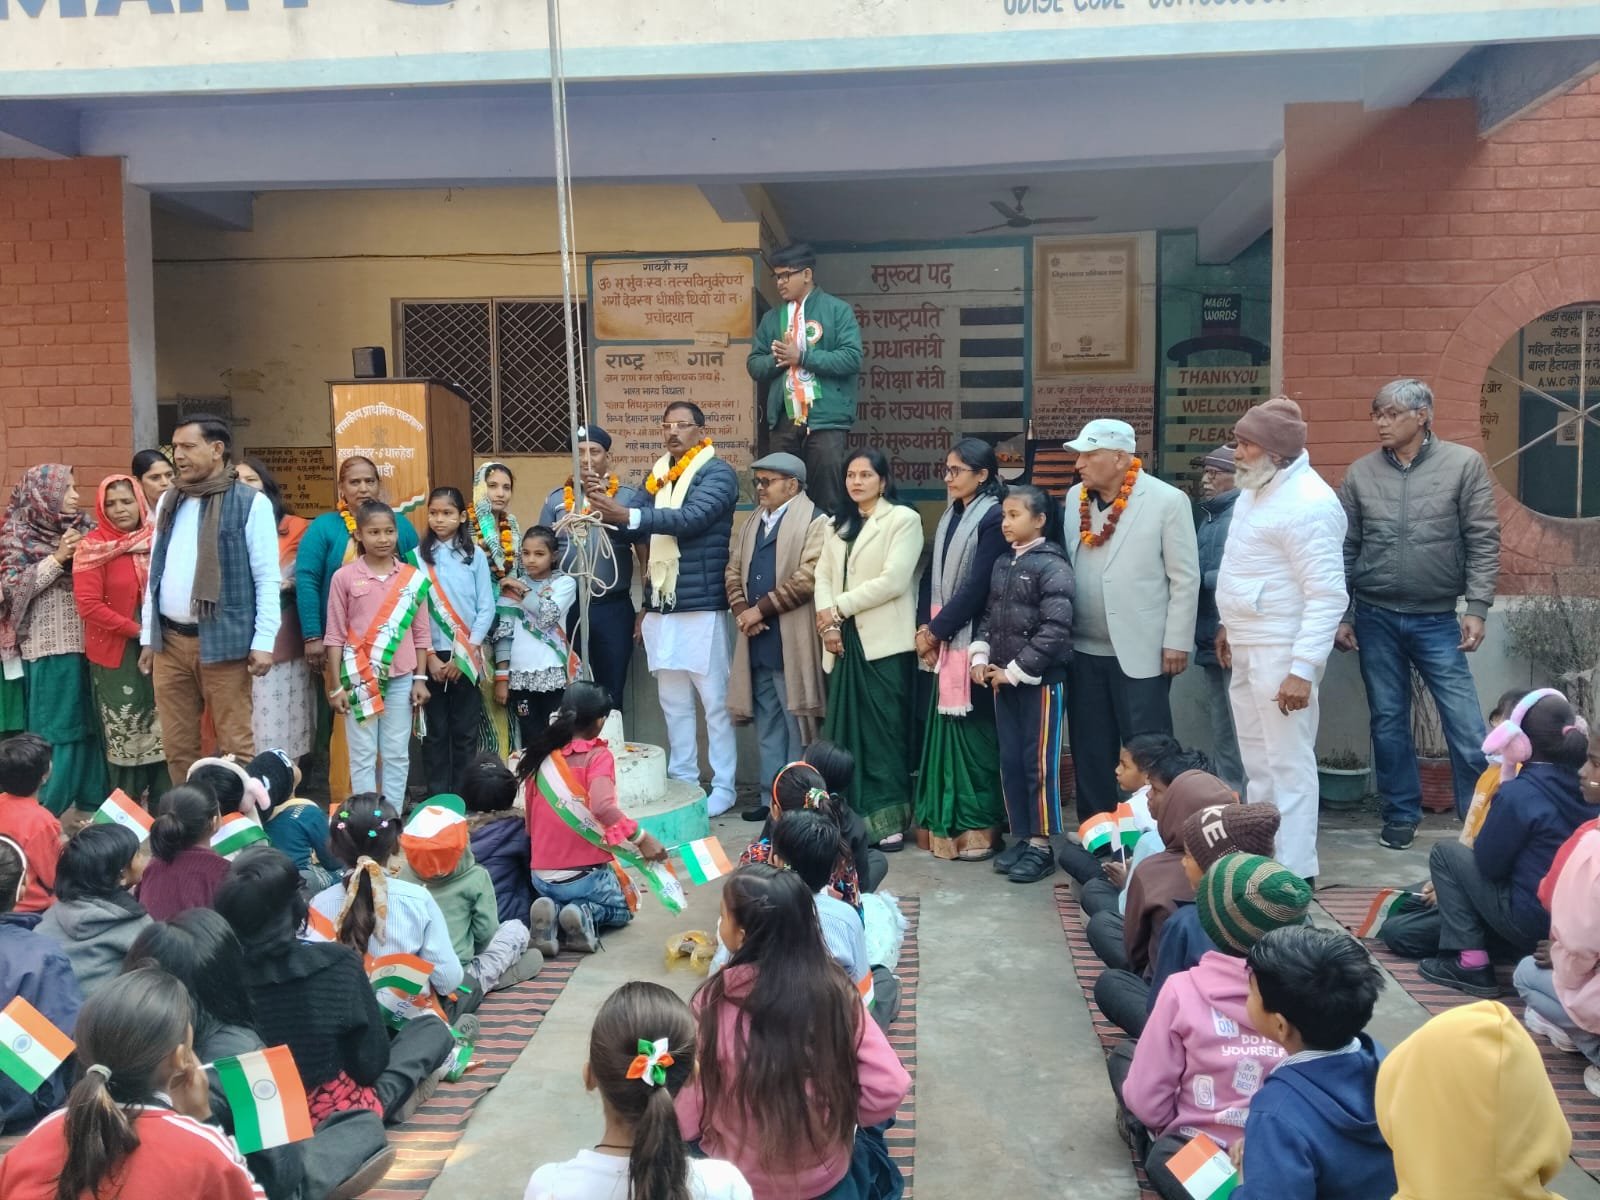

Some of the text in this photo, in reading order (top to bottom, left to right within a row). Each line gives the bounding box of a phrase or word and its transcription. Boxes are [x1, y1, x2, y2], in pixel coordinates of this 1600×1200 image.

[643, 261, 689, 273] गायत्री मंत्र
[871, 263, 954, 292] मुख्य पद
[713, 291, 726, 305] यो
[1204, 297, 1232, 308] MAGIC
[873, 301, 944, 332] राष्ट्रपति
[1204, 310, 1238, 321] WORDS
[872, 333, 945, 359] प्रधानमंत्री
[606, 353, 645, 371] राष्ट्र
[687, 352, 725, 367] गान
[871, 366, 914, 394] शिक्षा
[916, 364, 946, 390] मंत्री
[869, 396, 886, 421] के
[888, 401, 953, 421] राज्यपाल
[868, 426, 885, 450] के
[885, 426, 953, 455] मुख्यमंत्री
[889, 456, 931, 486] शिक्षा
[1218, 1019, 1236, 1034] ON
[1241, 1034, 1259, 1045] DO
[1221, 1045, 1285, 1059] YOURSELF
